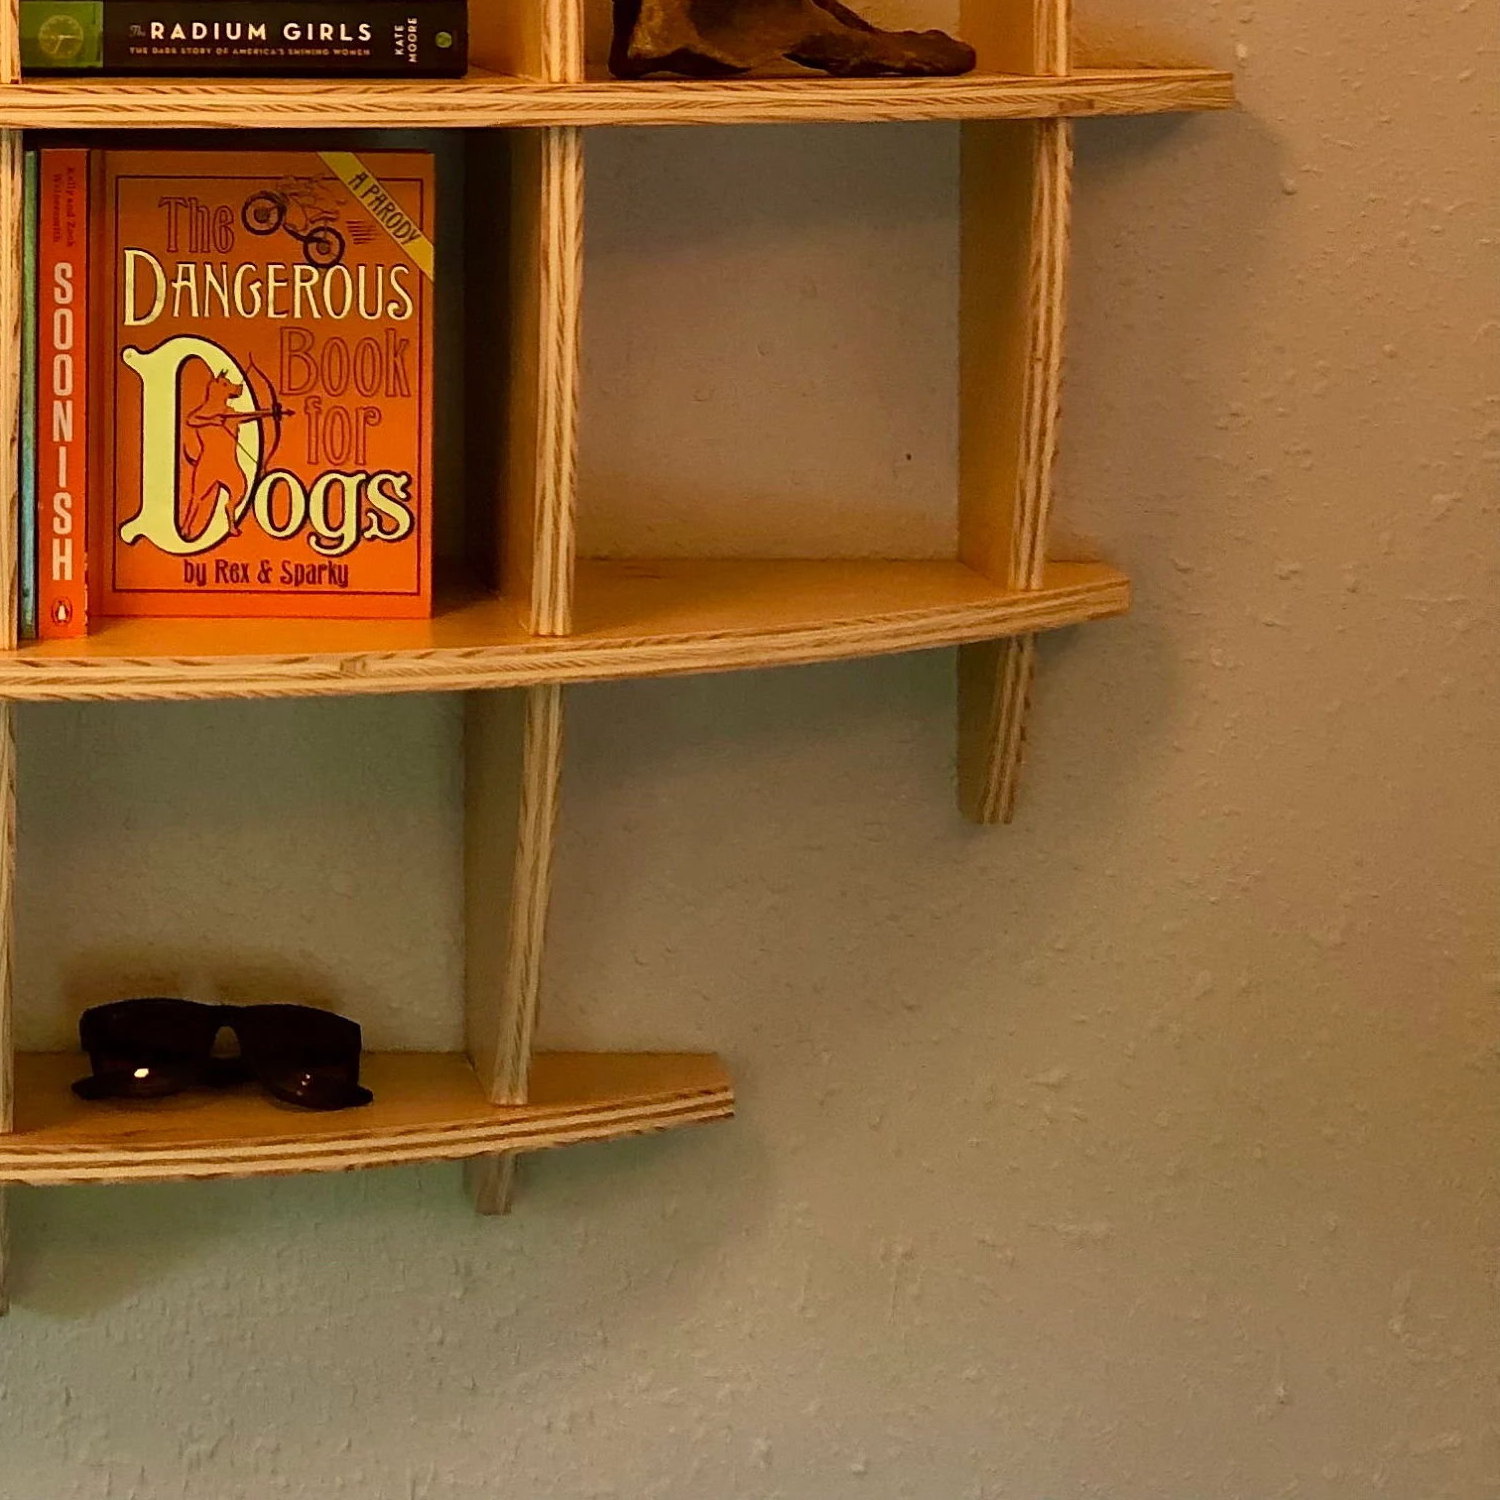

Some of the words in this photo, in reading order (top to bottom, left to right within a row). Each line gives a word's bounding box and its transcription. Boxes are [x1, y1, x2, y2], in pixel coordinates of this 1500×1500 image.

[129, 47, 148, 55] THE
[152, 47, 177, 55] DARK
[181, 47, 212, 56] STORY
[216, 47, 228, 56] OF
[232, 47, 285, 56] AMERICA'S
[288, 48, 330, 56] SHINING
[333, 48, 371, 56] WOMEN
[150, 22, 267, 41] RADIUM
[283, 22, 372, 42] GIRLS
[394, 24, 405, 56] KATE
[407, 17, 418, 63] MOORE
[66, 198, 77, 218] and
[157, 196, 236, 255] The
[348, 171, 369, 191] A
[360, 184, 422, 245] PARODY
[123, 246, 414, 327] DANGEROUS
[278, 326, 411, 398] Book
[52, 261, 74, 582] SOONISH
[117, 332, 416, 557] Dogs
[304, 394, 383, 466] for
[182, 558, 207, 588] by
[215, 559, 250, 584] Rex
[257, 559, 273, 584] &
[281, 559, 349, 588] Sparky
